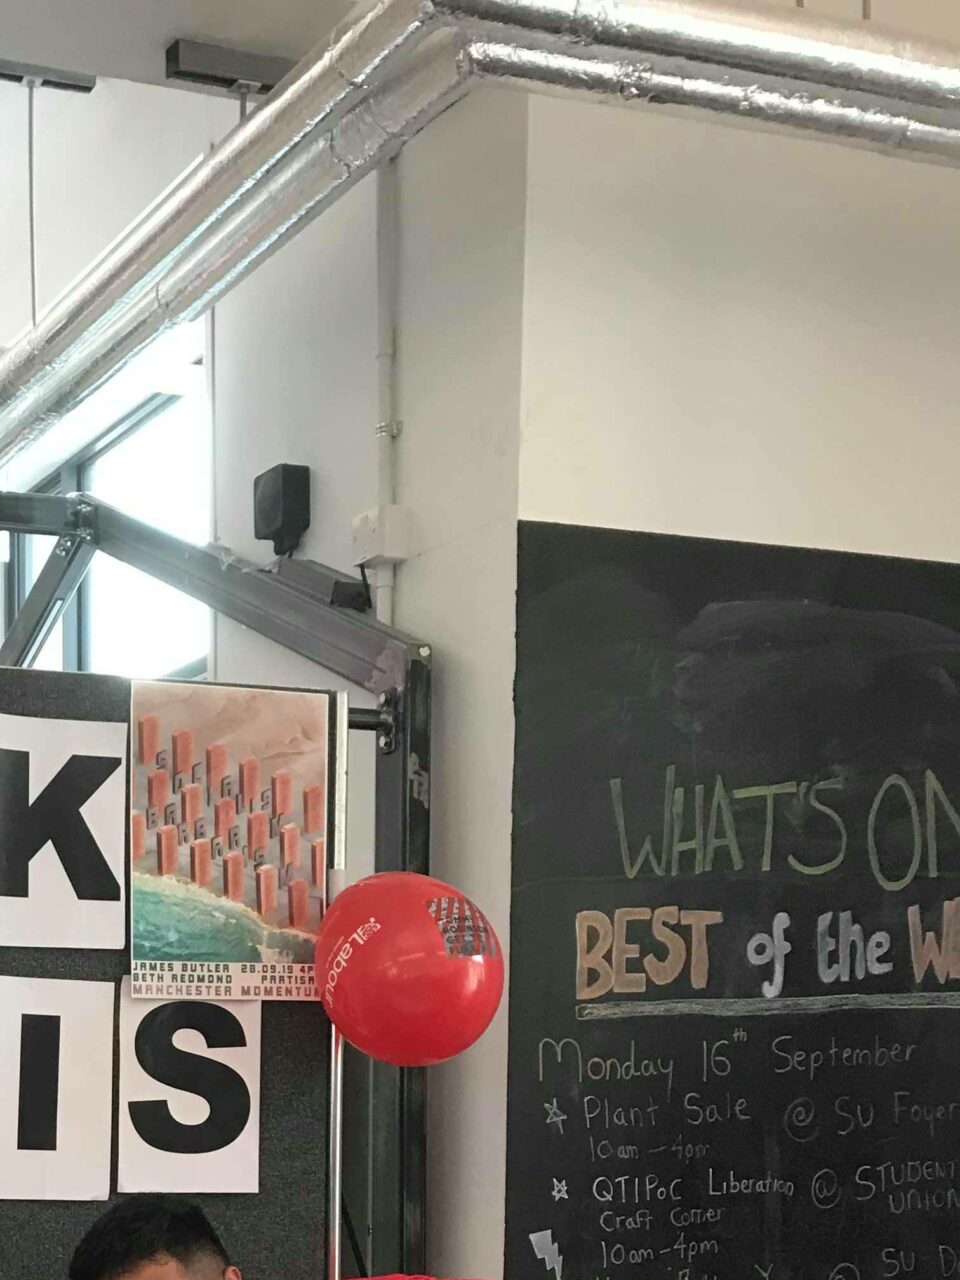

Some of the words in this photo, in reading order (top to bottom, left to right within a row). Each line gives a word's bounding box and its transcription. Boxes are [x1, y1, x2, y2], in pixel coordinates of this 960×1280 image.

[610, 765, 848, 879] WHAT'S
[133, 962, 174, 972] JAMES
[181, 963, 230, 973] BUTLER
[576, 905, 724, 1000] BEST
[747, 912, 791, 998] of
[818, 910, 893, 984] the
[133, 973, 165, 983] BETH
[172, 974, 233, 984] REDMOND
[261, 975, 315, 985] PARTISA
[133, 984, 233, 997] MANCHESTER
[539, 1037, 674, 1102] Monday
[772, 1035, 918, 1080] September
[584, 1095, 660, 1129] Plant
[683, 1092, 752, 1125] Sale
[784, 1096, 820, 1142] @
[708, 1167, 795, 1197] Liberation
[811, 1168, 841, 1209] @
[599, 1209, 654, 1232] Craft
[670, 1207, 727, 1227] Corner
